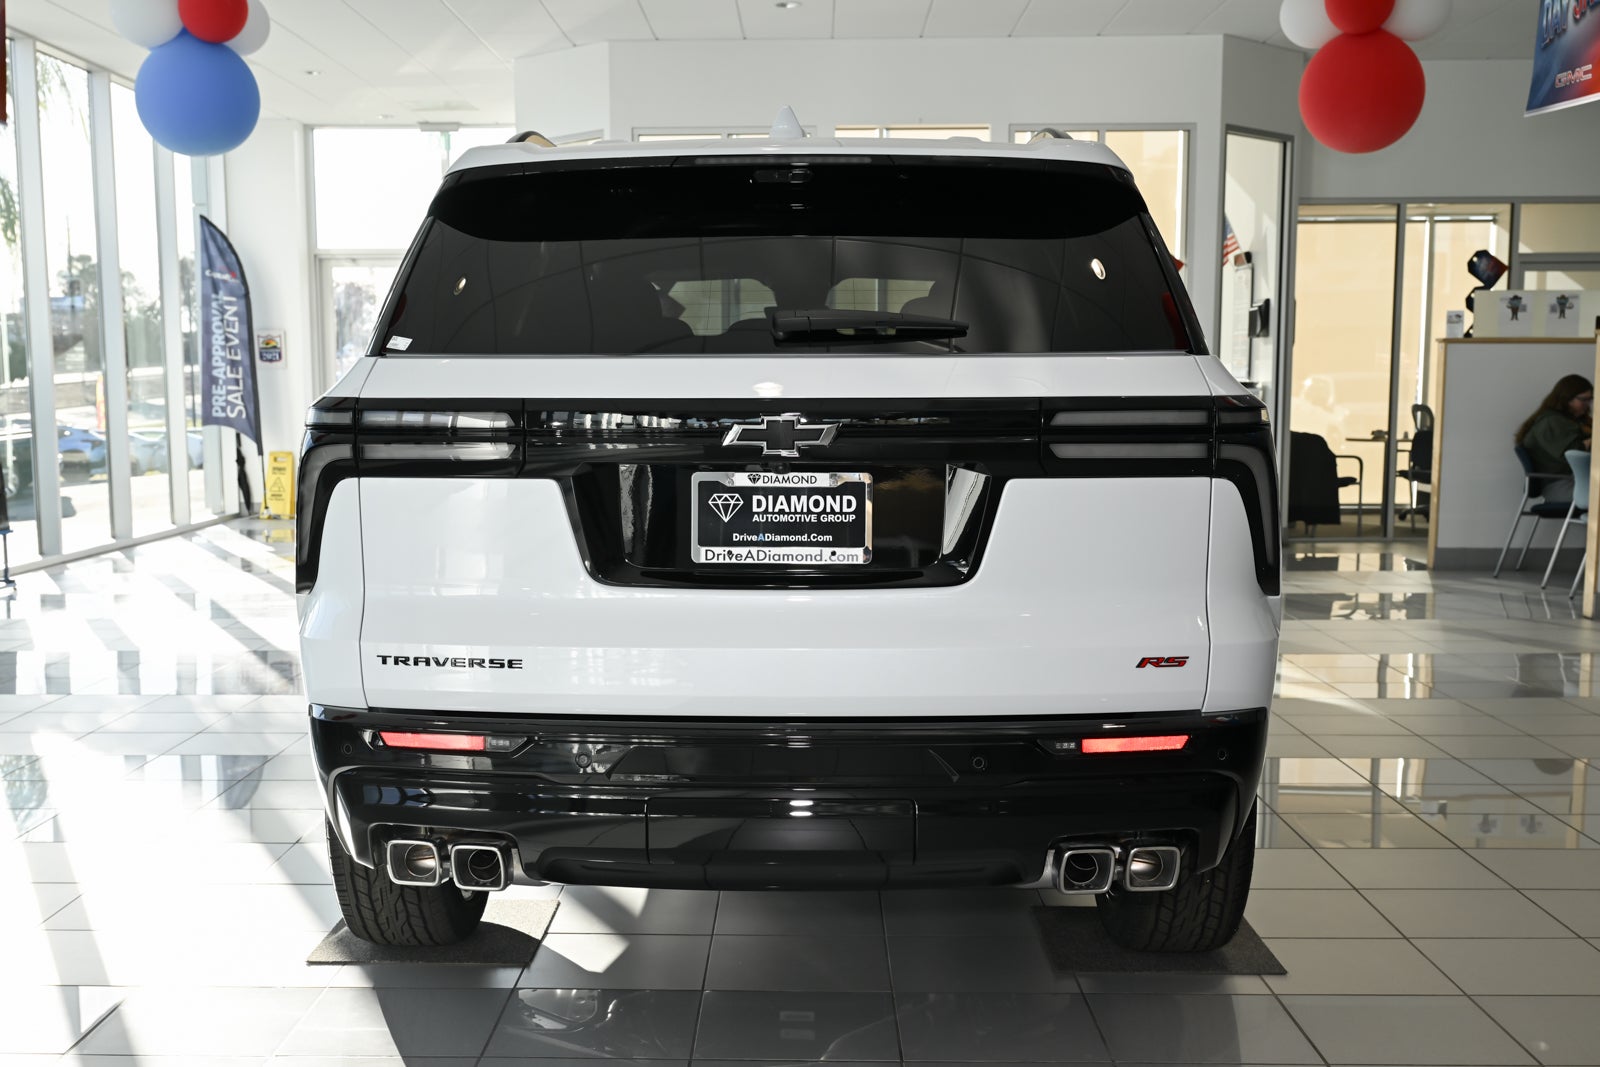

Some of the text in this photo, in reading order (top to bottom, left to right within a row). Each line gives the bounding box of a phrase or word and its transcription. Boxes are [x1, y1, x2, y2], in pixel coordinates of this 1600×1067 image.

[1555, 64, 1592, 88] GMC
[211, 290, 226, 418] PRE-APPROVAL
[224, 295, 246, 419] SALE EVENT
[762, 475, 817, 485] DIAMOND
[752, 495, 857, 513] DIAMOND
[752, 514, 856, 523] AUTOMOTIVE GROUP
[732, 533, 833, 542] DriveADiamond.Com
[705, 549, 859, 562] DriveADiamond.com
[376, 654, 523, 669] TRAVERSE
[1135, 656, 1190, 668] RS
